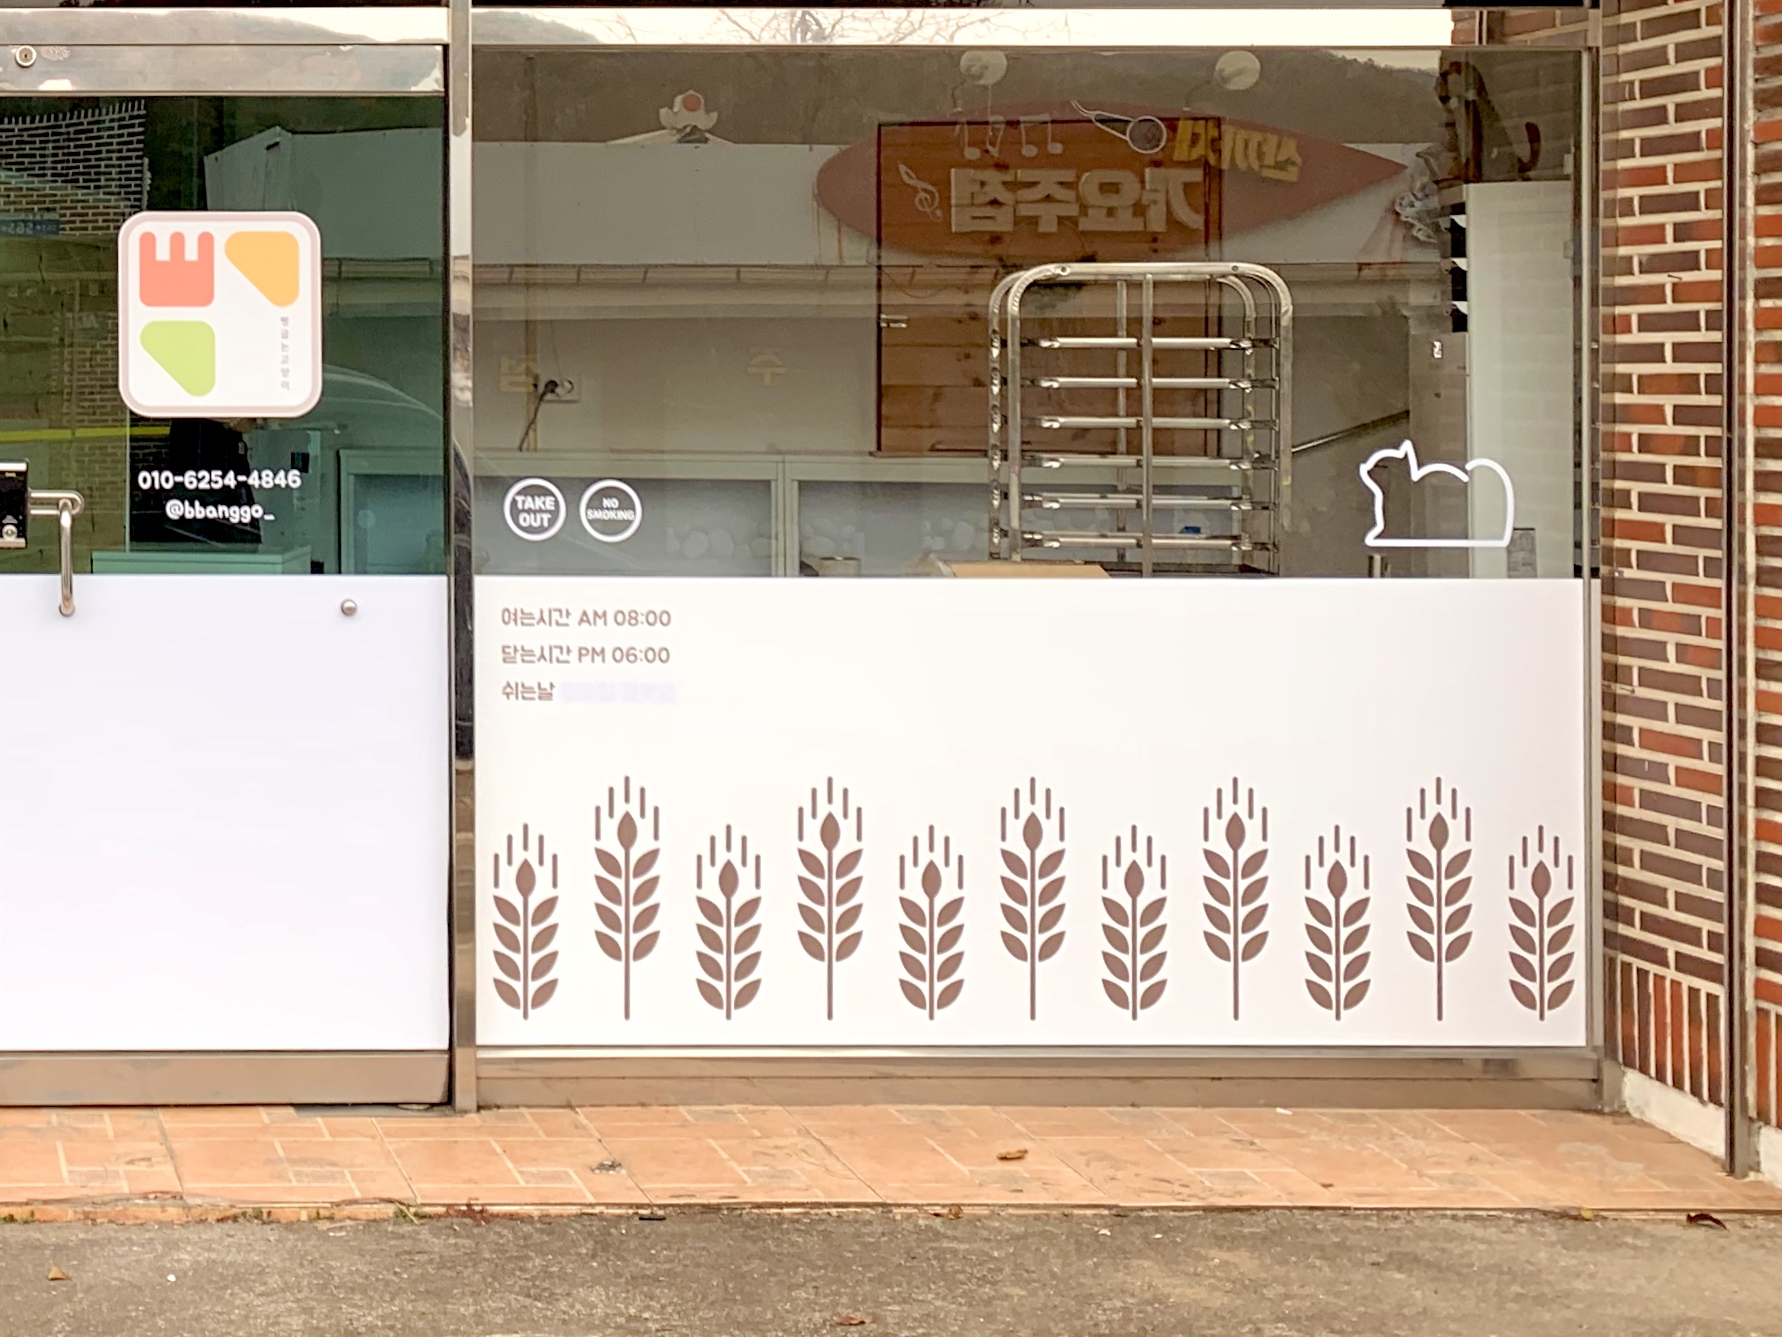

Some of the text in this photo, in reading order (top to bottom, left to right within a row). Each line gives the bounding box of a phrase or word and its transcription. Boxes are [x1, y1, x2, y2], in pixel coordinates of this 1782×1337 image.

[137, 469, 303, 491] 010-6254-4846
[164, 498, 276, 524] @bbanggo_
[514, 494, 556, 511] TAKE
[602, 497, 620, 509] NO
[518, 512, 553, 528] OUT
[586, 508, 636, 521] SMOKING
[501, 607, 673, 627] 여는시간 AM 08:00
[501, 644, 671, 664] 닫는시간 PM 06:00
[501, 681, 556, 701] 쉬는날
